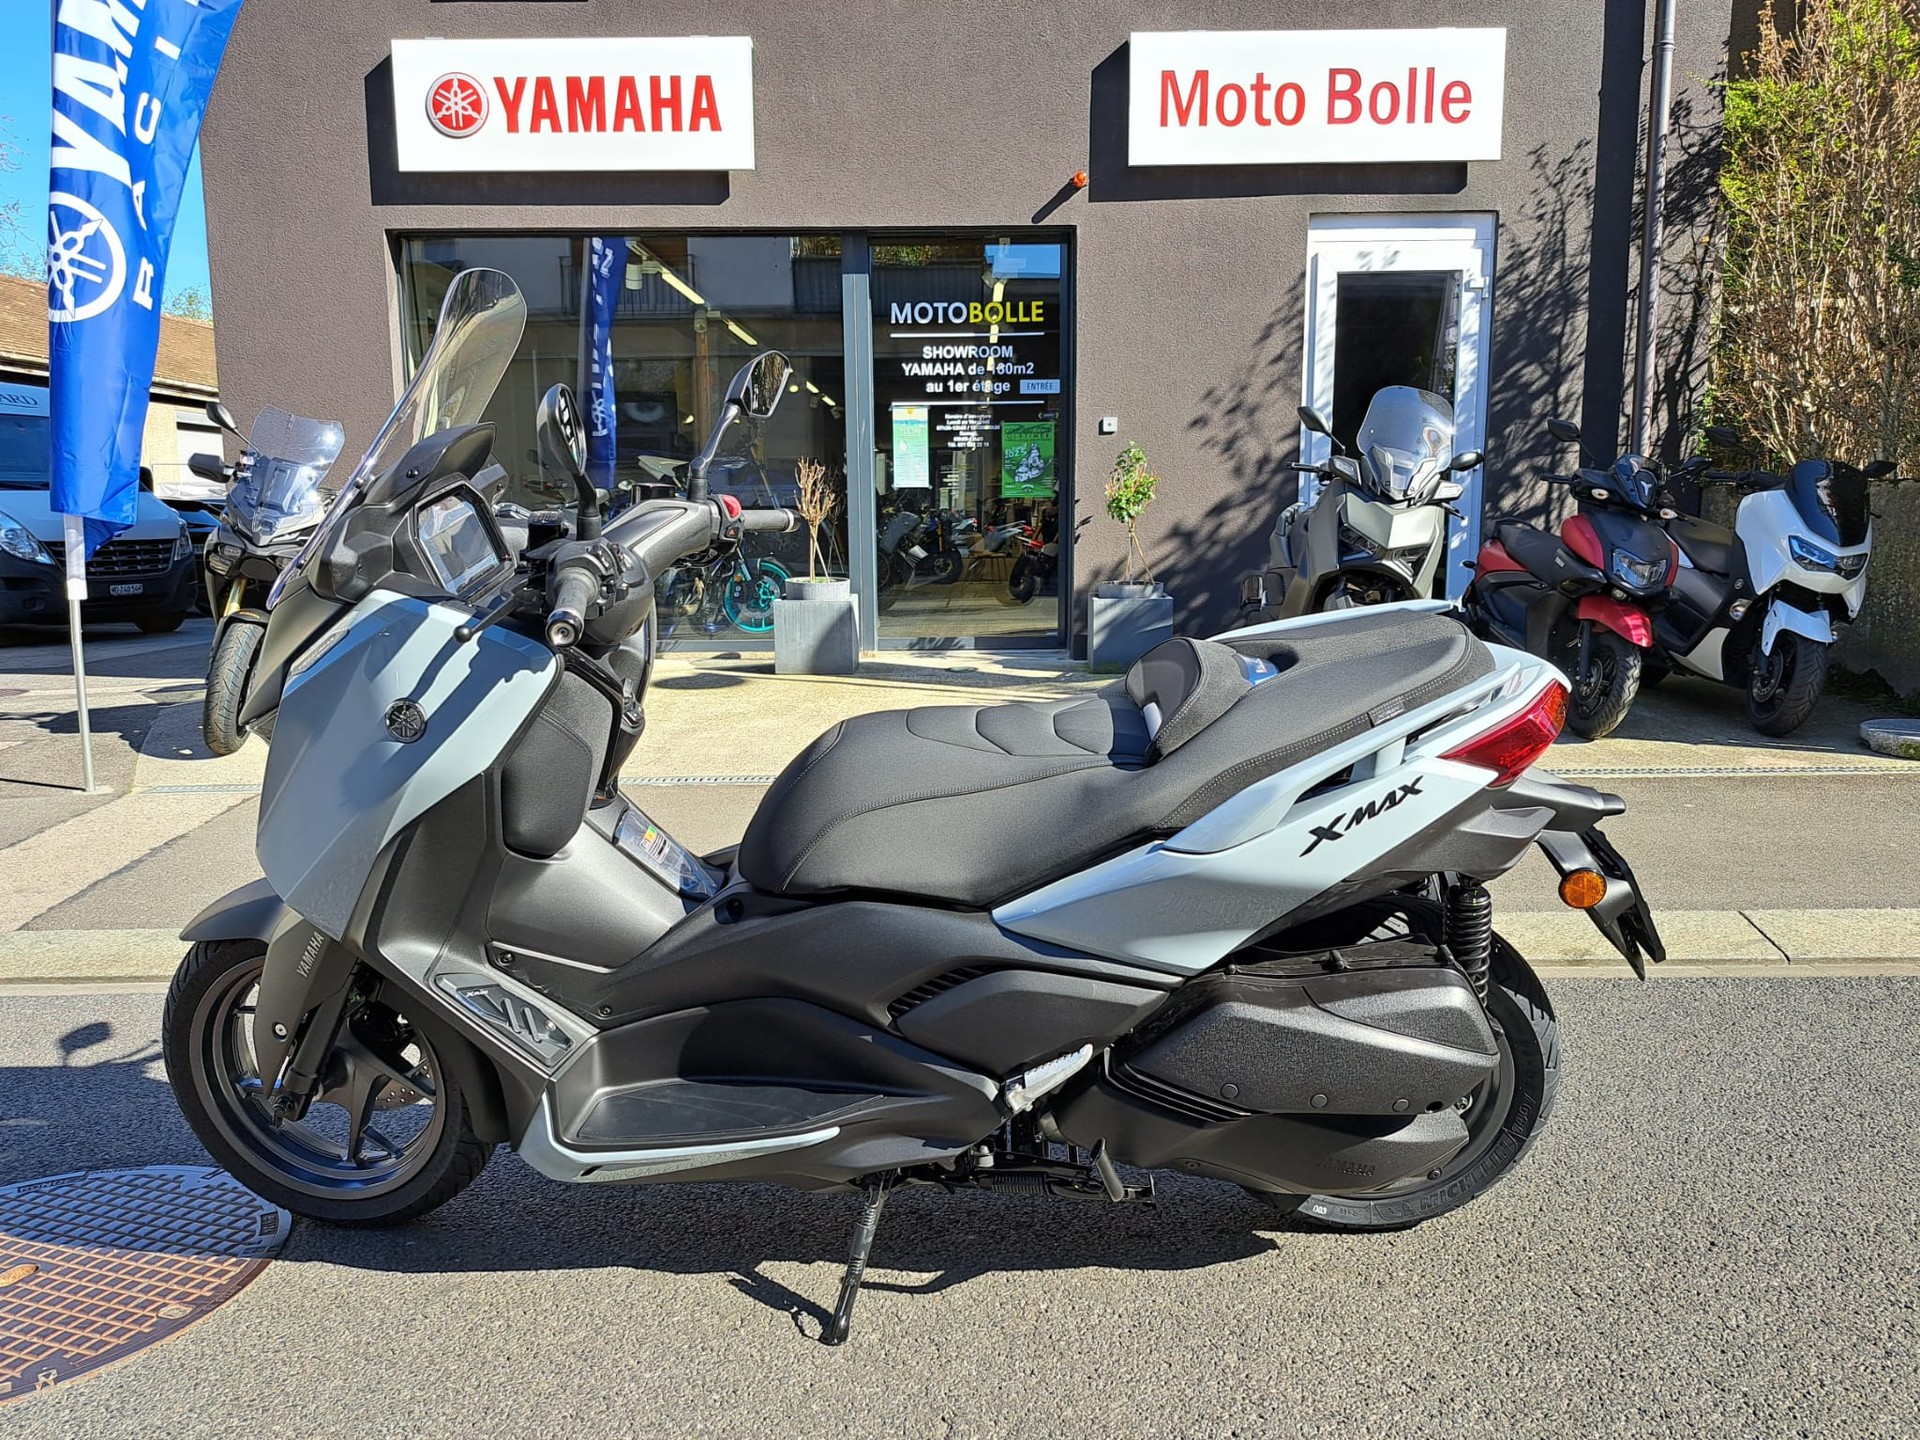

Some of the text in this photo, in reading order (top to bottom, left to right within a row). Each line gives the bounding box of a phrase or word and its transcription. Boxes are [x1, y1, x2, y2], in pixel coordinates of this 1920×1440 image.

[493, 75, 722, 133] YAMAHA
[1159, 67, 1473, 127] Moto Bolle
[890, 301, 1044, 324] MOTOBOLLE
[923, 345, 1013, 359] SHOWROOM
[901, 363, 965, 376] YAMAHA
[968, 363, 985, 376] de
[926, 379, 1011, 394] au 1er étage
[1026, 381, 1054, 391] ENTRÉE
[1299, 775, 1424, 857] XMAX
[296, 931, 325, 979] YAMAHA
